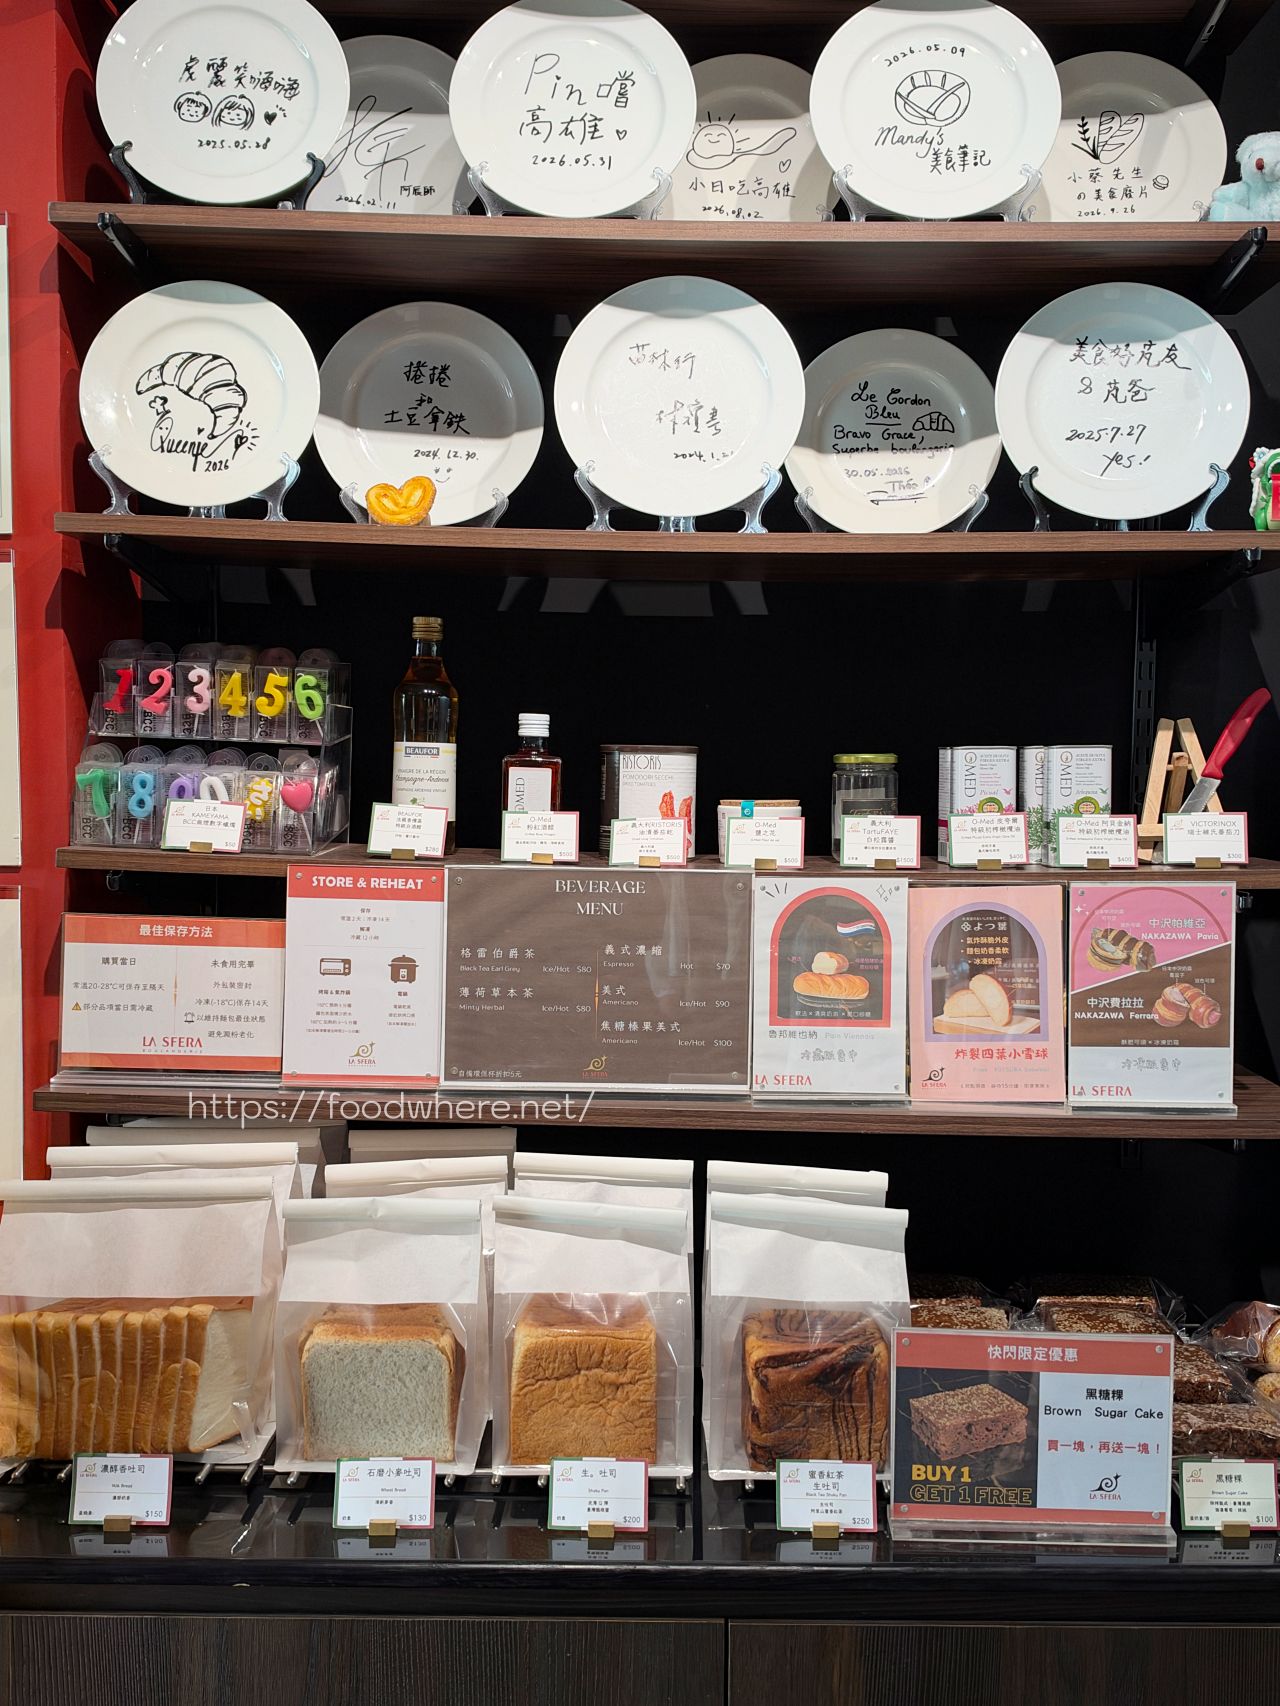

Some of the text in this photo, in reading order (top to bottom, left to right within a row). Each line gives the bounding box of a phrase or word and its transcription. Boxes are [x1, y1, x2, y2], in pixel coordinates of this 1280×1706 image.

[884, 43, 966, 67] 2026.05.09
[874, 126, 945, 159] Mandy's
[532, 154, 612, 170] 2026.05.31
[851, 381, 877, 402] Le
[865, 404, 900, 419] Bleu
[833, 425, 871, 439] Bravo
[204, 459, 229, 472] 2026
[140, 668, 173, 715] 2
[186, 668, 210, 713] 3
[218, 672, 247, 717] 4
[256, 673, 289, 717] 5
[295, 675, 324, 720] 6
[406, 747, 439, 755] BEAUFOR
[622, 755, 662, 770] RISTORIS
[965, 752, 977, 798] OMED
[1060, 751, 1073, 797] OMED
[76, 768, 111, 818] 7
[128, 772, 154, 818] 8
[312, 875, 423, 890] STORE & REHEAT
[555, 880, 646, 894] BEVERAGE
[576, 902, 624, 915] MENU
[139, 924, 213, 938] 最佳保存方法
[460, 948, 535, 959] 格雷伯爵茶
[604, 944, 663, 956] 義式濃縮
[102, 957, 137, 966] 購買當日
[211, 959, 255, 968] 未食用完畢
[459, 987, 534, 998] 薄荷草本茶
[602, 985, 626, 996] 美式
[459, 1004, 480, 1012] Minty
[680, 1000, 706, 1008] Ice/Hot
[600, 1020, 681, 1032] 焦糖榛果美式
[143, 1036, 203, 1048] LA SFERA
[955, 1048, 1048, 1060] 炸裂四葉小雪球
[755, 1075, 812, 1086] LA SFERA
[1072, 1086, 1132, 1096] LA SFERA
[987, 1345, 1078, 1362] 快閃限定優惠
[1085, 1388, 1124, 1401] 黑糖粿
[1044, 1405, 1164, 1419] Brown Sugar Cake
[101, 1464, 145, 1474] 濃醇香吐司
[809, 1470, 844, 1480] 蜜香紅茶
[911, 1464, 971, 1482] BUY 1
[813, 1482, 840, 1491] 生吐司
[910, 1485, 1032, 1505] GET 1 FREE
